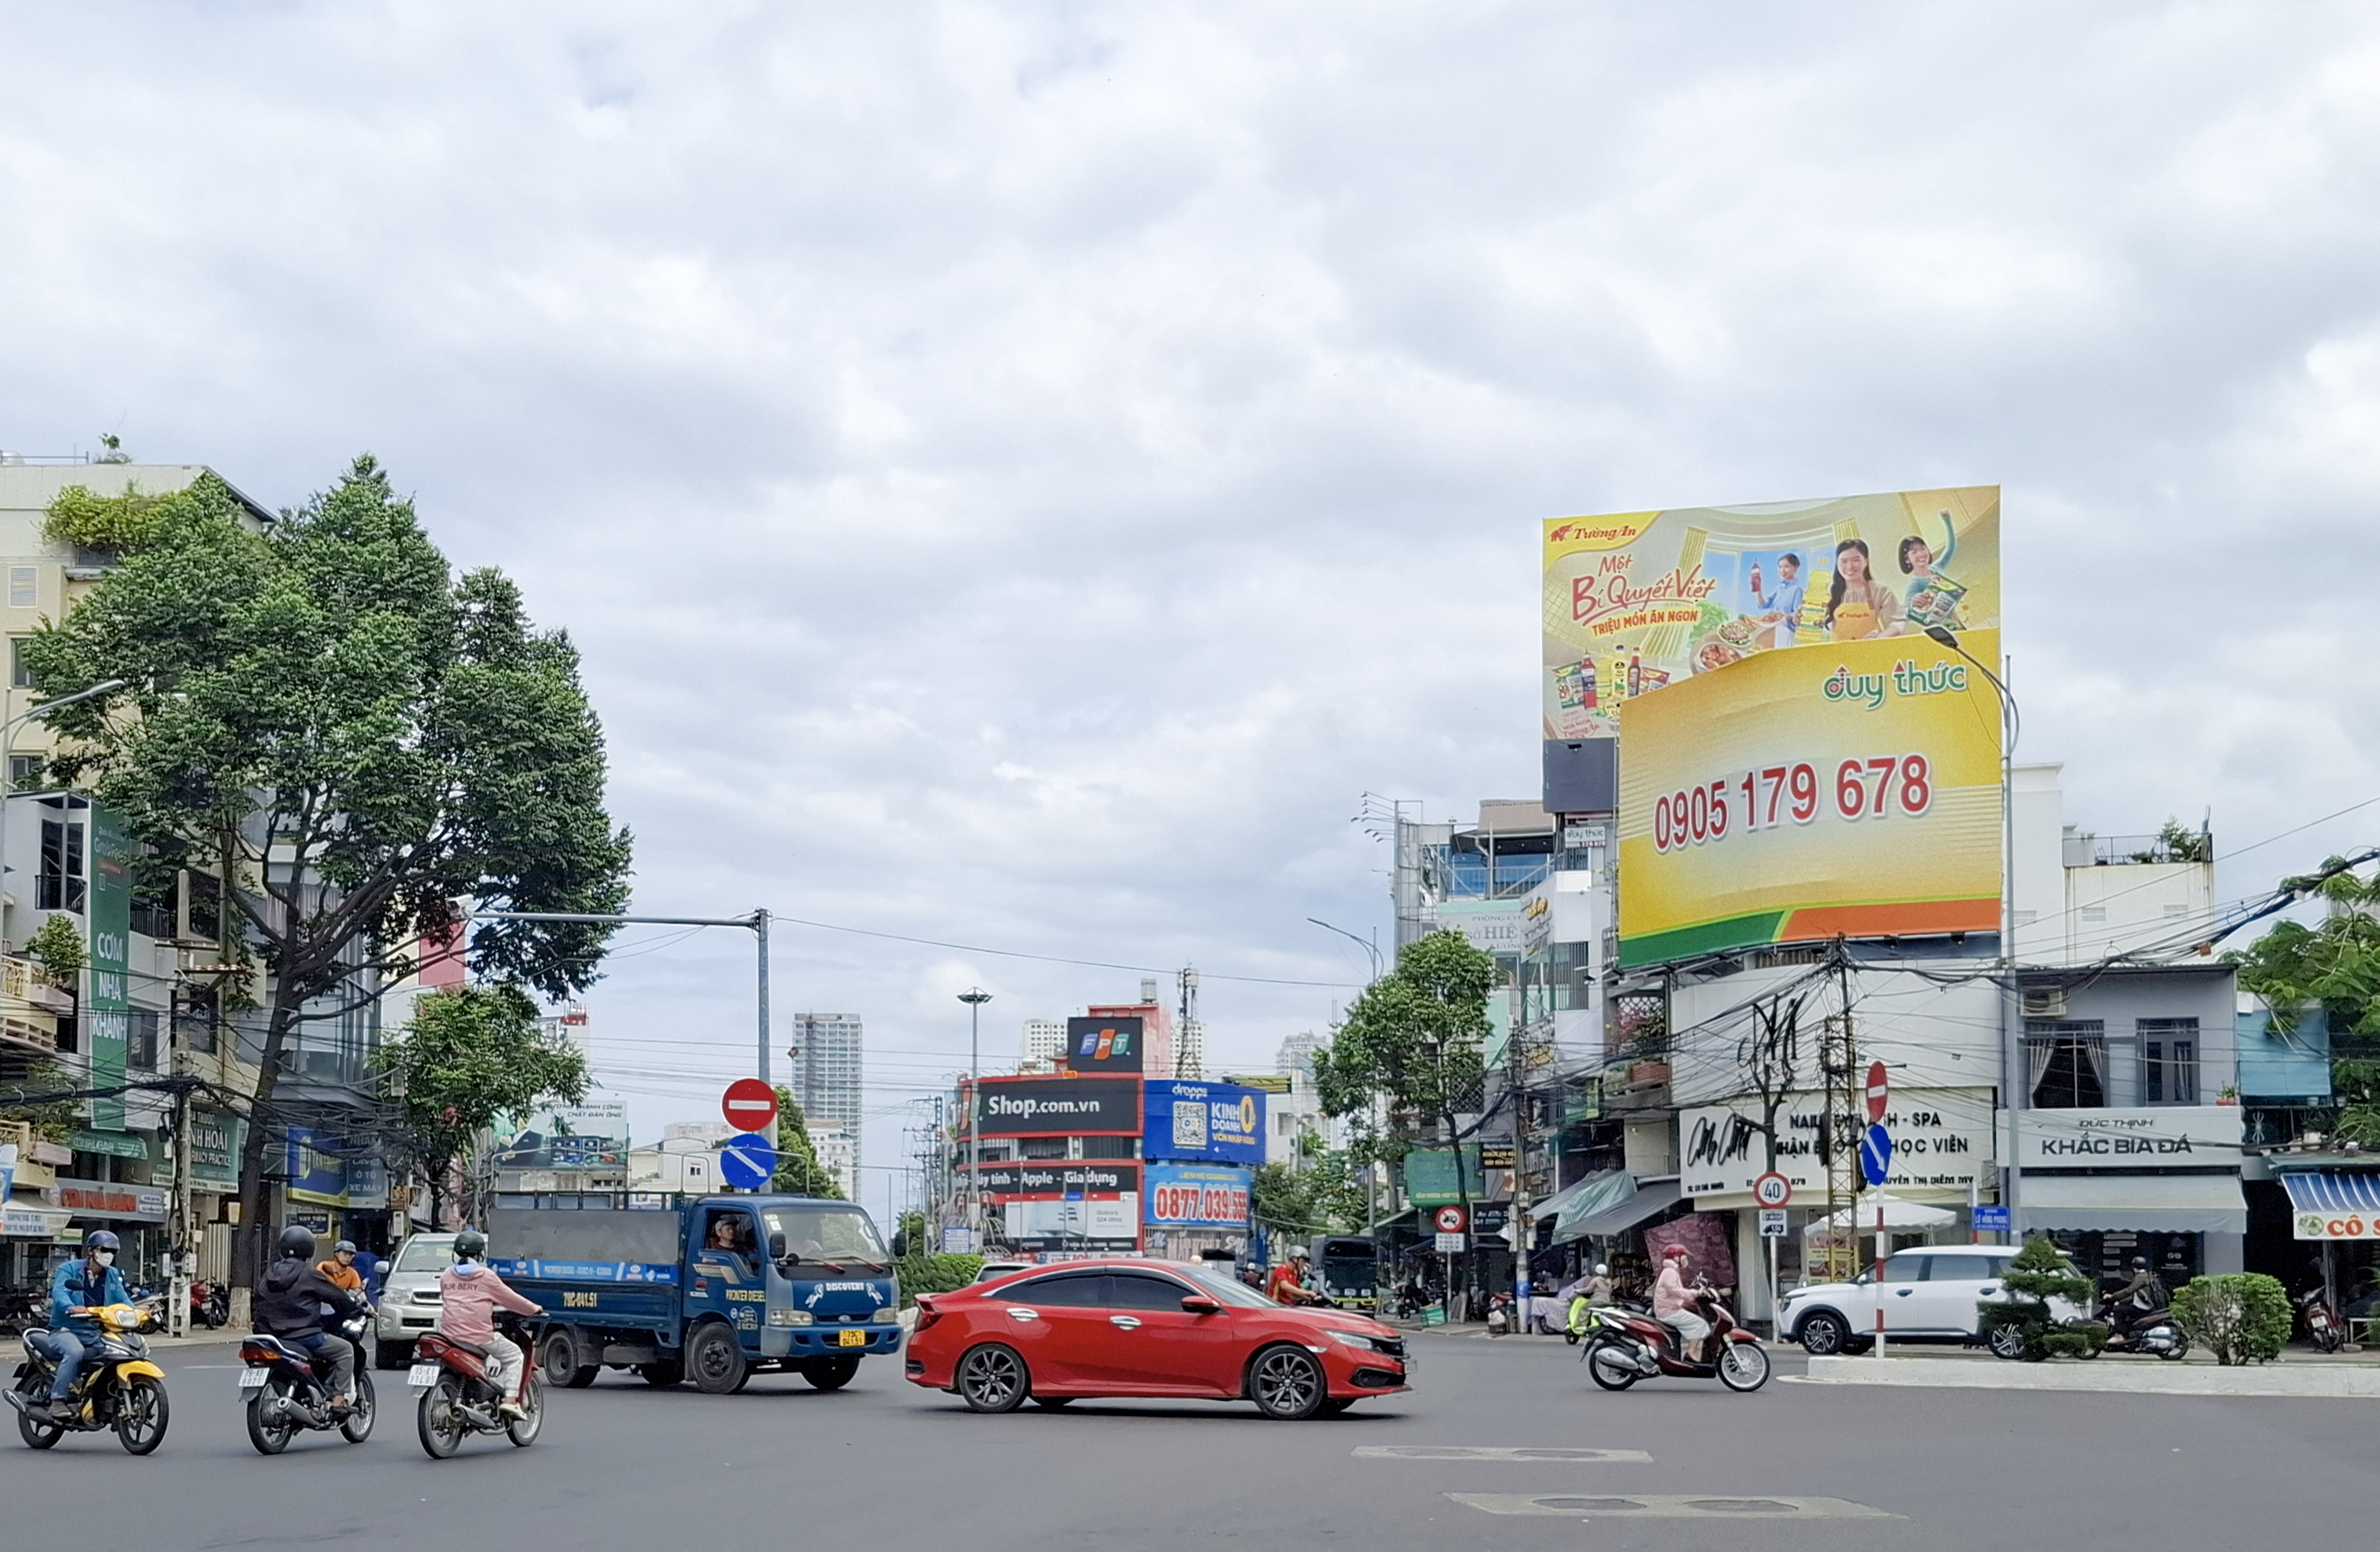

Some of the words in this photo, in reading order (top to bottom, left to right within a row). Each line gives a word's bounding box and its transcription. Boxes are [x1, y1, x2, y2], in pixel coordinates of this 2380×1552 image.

[1574, 527, 1617, 540] Tường
[1598, 554, 1633, 576] Một
[1573, 575, 1605, 621] Bí
[1607, 573, 1674, 611] Quyết
[1675, 564, 1716, 602] Việt
[1591, 617, 1621, 637] TRIỆU
[1623, 610, 1647, 629] MÓN
[1650, 610, 1665, 624] ĂN
[1667, 610, 1699, 623] NGON
[1892, 659, 1966, 695] thức
[1654, 778, 1728, 853] 0905
[1741, 762, 1818, 831] 179
[1835, 752, 1930, 820] 678
[97, 932, 123, 963] CƠM
[99, 968, 121, 1002] NHÀ
[92, 1005, 127, 1042] KHÁNH
[989, 1095, 1100, 1119] Shop.com.vn
[1212, 1102, 1240, 1121] KINH
[1913, 1112, 1941, 1127] SPA
[2078, 1117, 2109, 1127] ĐỨC
[2112, 1119, 2154, 1130] THỊNH
[205, 1126, 228, 1151] HOÀI
[1933, 1134, 1968, 1153] VIÊN
[2042, 1131, 2109, 1155] KHẮC
[2114, 1139, 2154, 1154] BIA
[2158, 1133, 2193, 1153] ĐÁ
[991, 1172, 1011, 1185] tính
[1021, 1172, 1053, 1187] Apple
[1065, 1171, 1084, 1183] Gia
[1087, 1170, 1117, 1187] dụng
[1765, 1182, 1780, 1198] 40
[2327, 1214, 2364, 1236] CÔ
[457, 1283, 478, 1291] BERY
[825, 1282, 864, 1291] DISCOVERY
